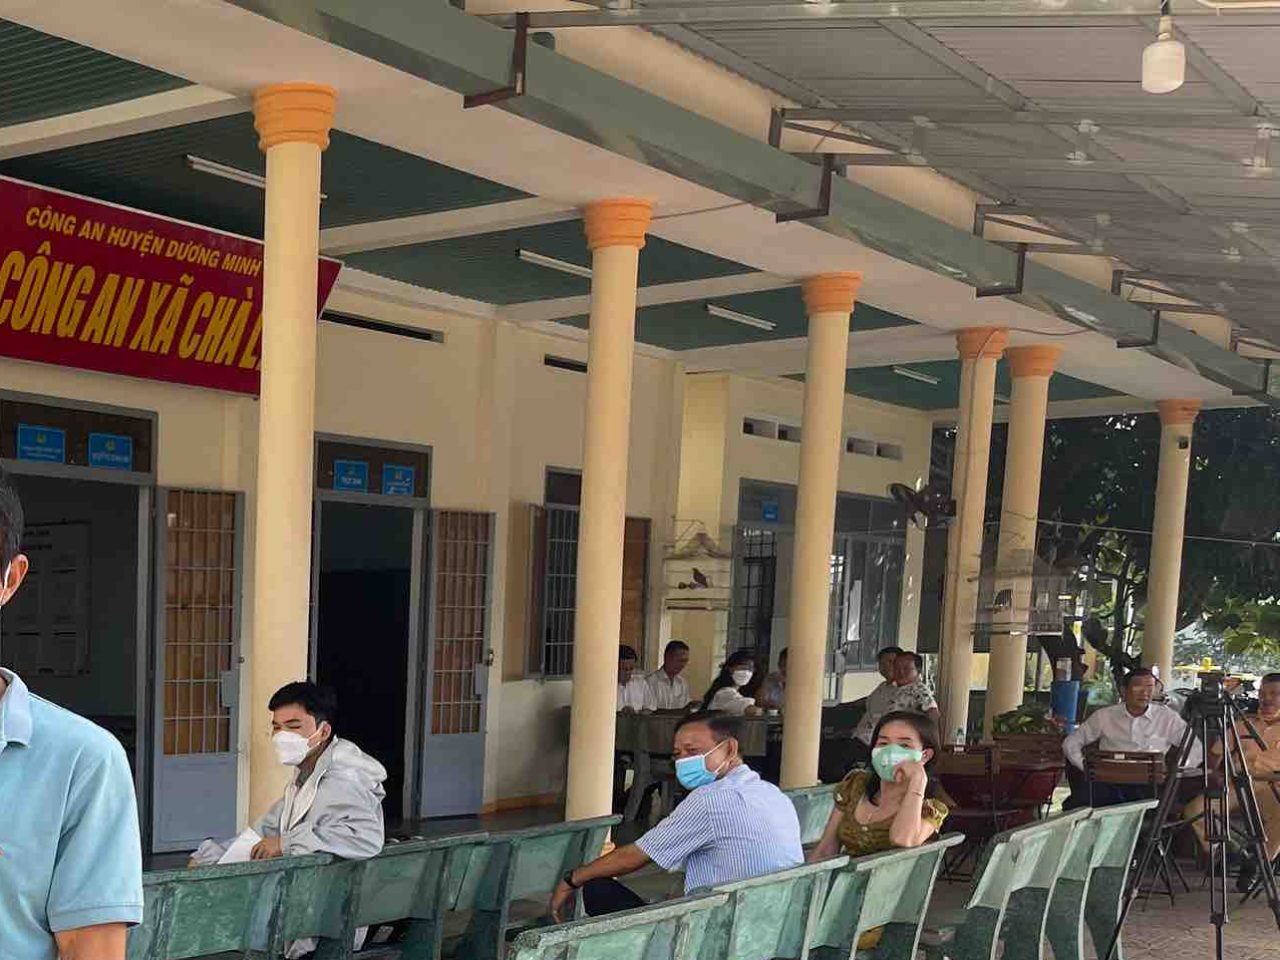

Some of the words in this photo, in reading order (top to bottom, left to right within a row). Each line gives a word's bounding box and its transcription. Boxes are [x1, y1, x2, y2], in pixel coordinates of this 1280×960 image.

[26, 204, 77, 236] CÔNG
[78, 220, 105, 242] AN
[107, 225, 165, 257] HUYỆN
[166, 240, 220, 268] DƯƠNG
[221, 252, 262, 277] MINH
[79, 272, 145, 348] AN
[129, 272, 195, 355] XÃ
[178, 286, 254, 367] CHÀ
[238, 312, 263, 371] L
